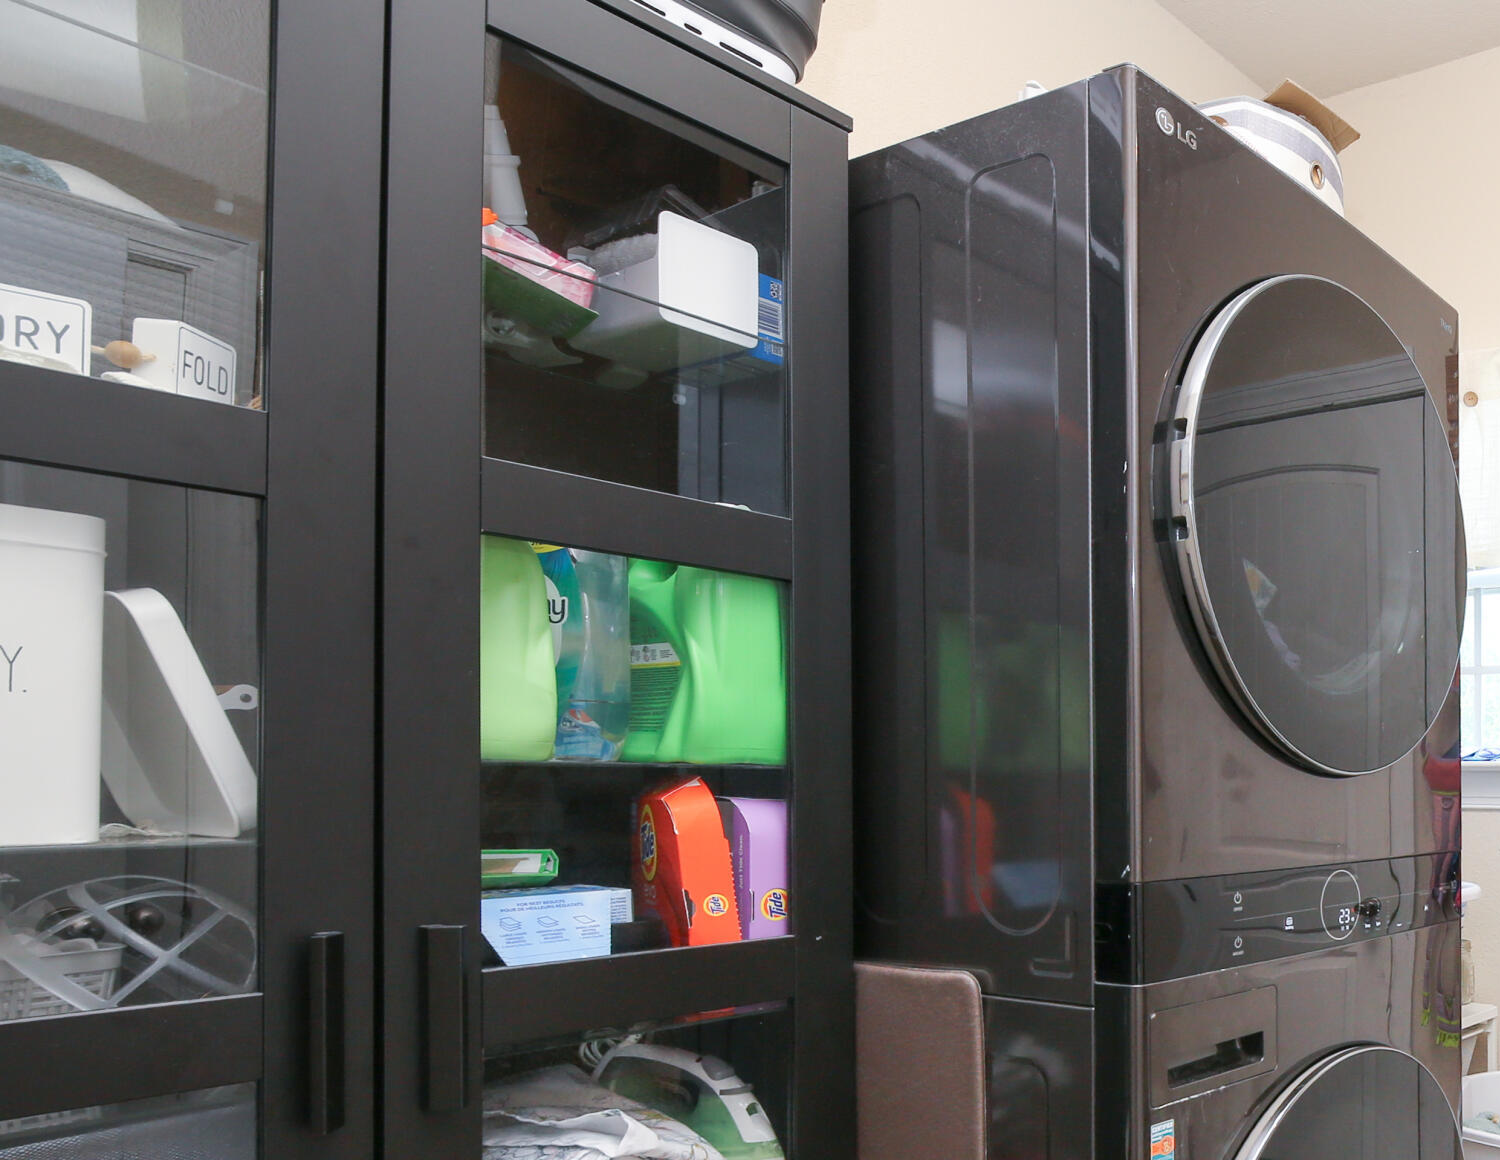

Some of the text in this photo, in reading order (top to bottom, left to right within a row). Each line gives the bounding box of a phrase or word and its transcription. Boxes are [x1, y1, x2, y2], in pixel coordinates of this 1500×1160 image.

[1177, 122, 1197, 150] LG
[0, 314, 70, 354] RY
[183, 350, 228, 395] FOLD
[709, 896, 725, 915] Tide
[767, 892, 787, 918] Tide
[1338, 908, 1351, 924] 23
